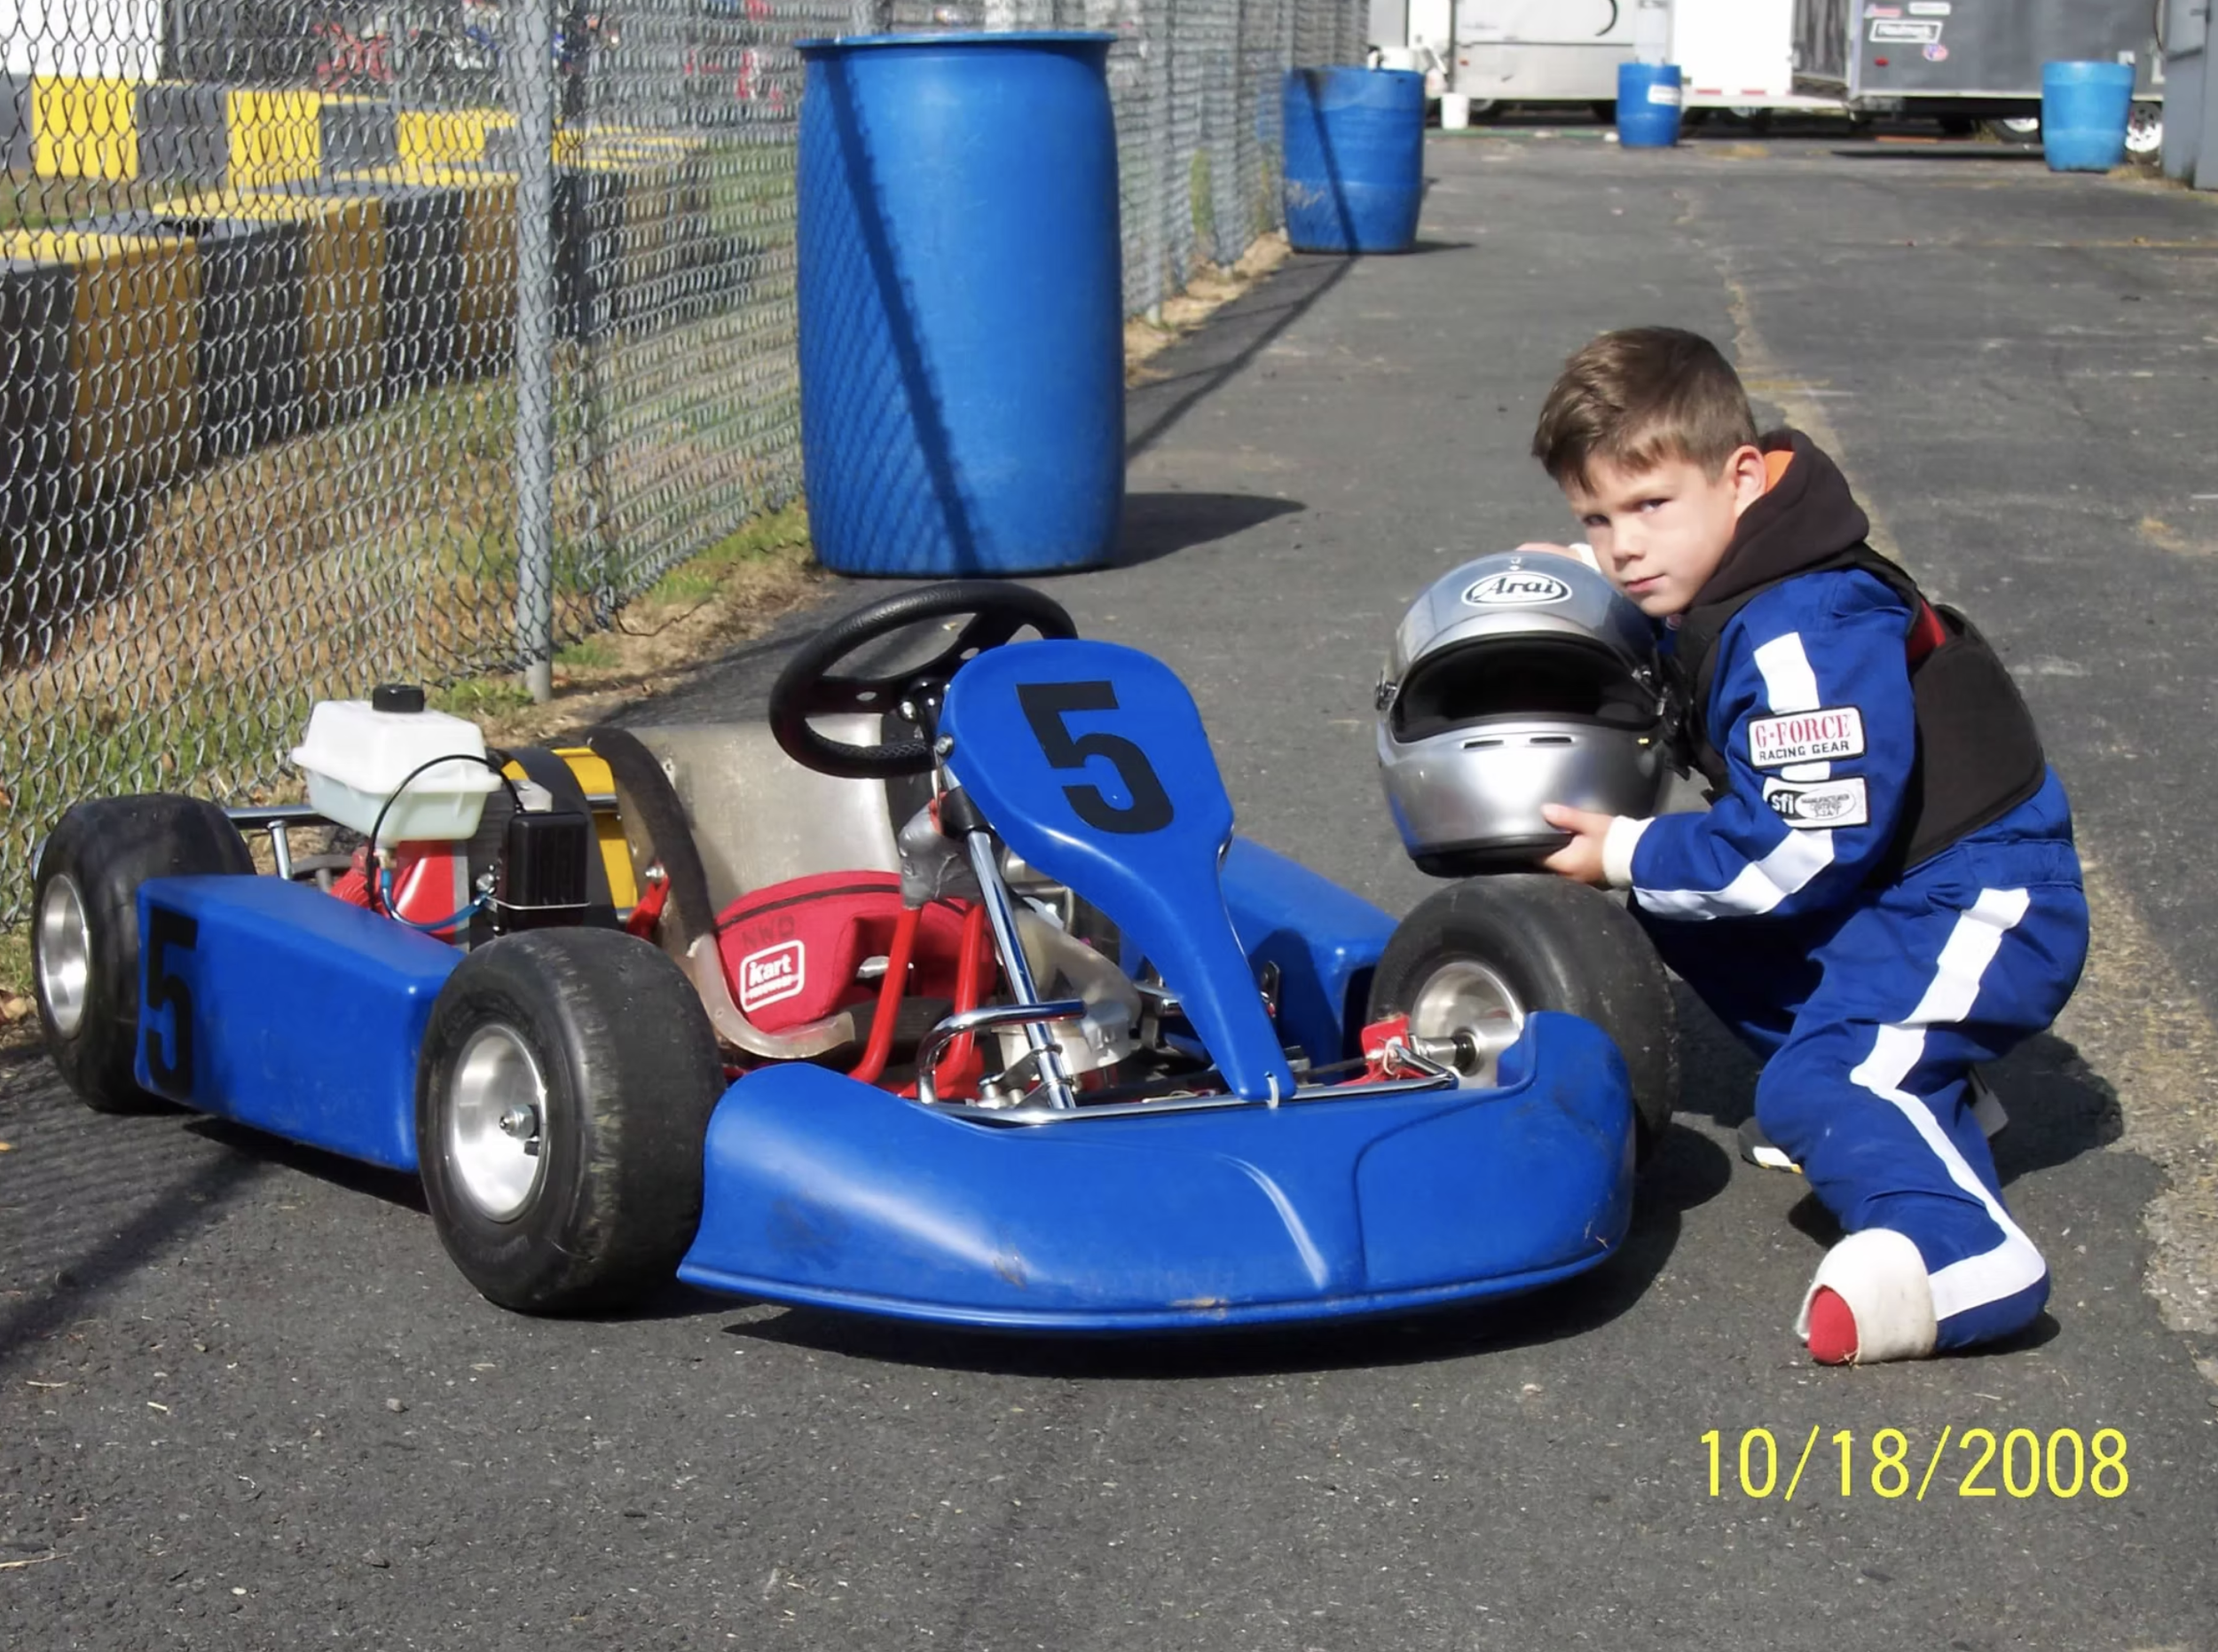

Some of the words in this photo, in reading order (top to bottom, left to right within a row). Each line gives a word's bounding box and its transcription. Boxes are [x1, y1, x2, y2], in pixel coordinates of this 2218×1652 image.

[1475, 577, 1554, 600] Arai
[1755, 714, 1852, 749] G-FORCE
[1016, 680, 1174, 834] 5
[1759, 746, 1805, 761] RACING
[1813, 741, 1850, 755] GEAR
[1771, 793, 1794, 814] sfi
[146, 905, 199, 1098] 5
